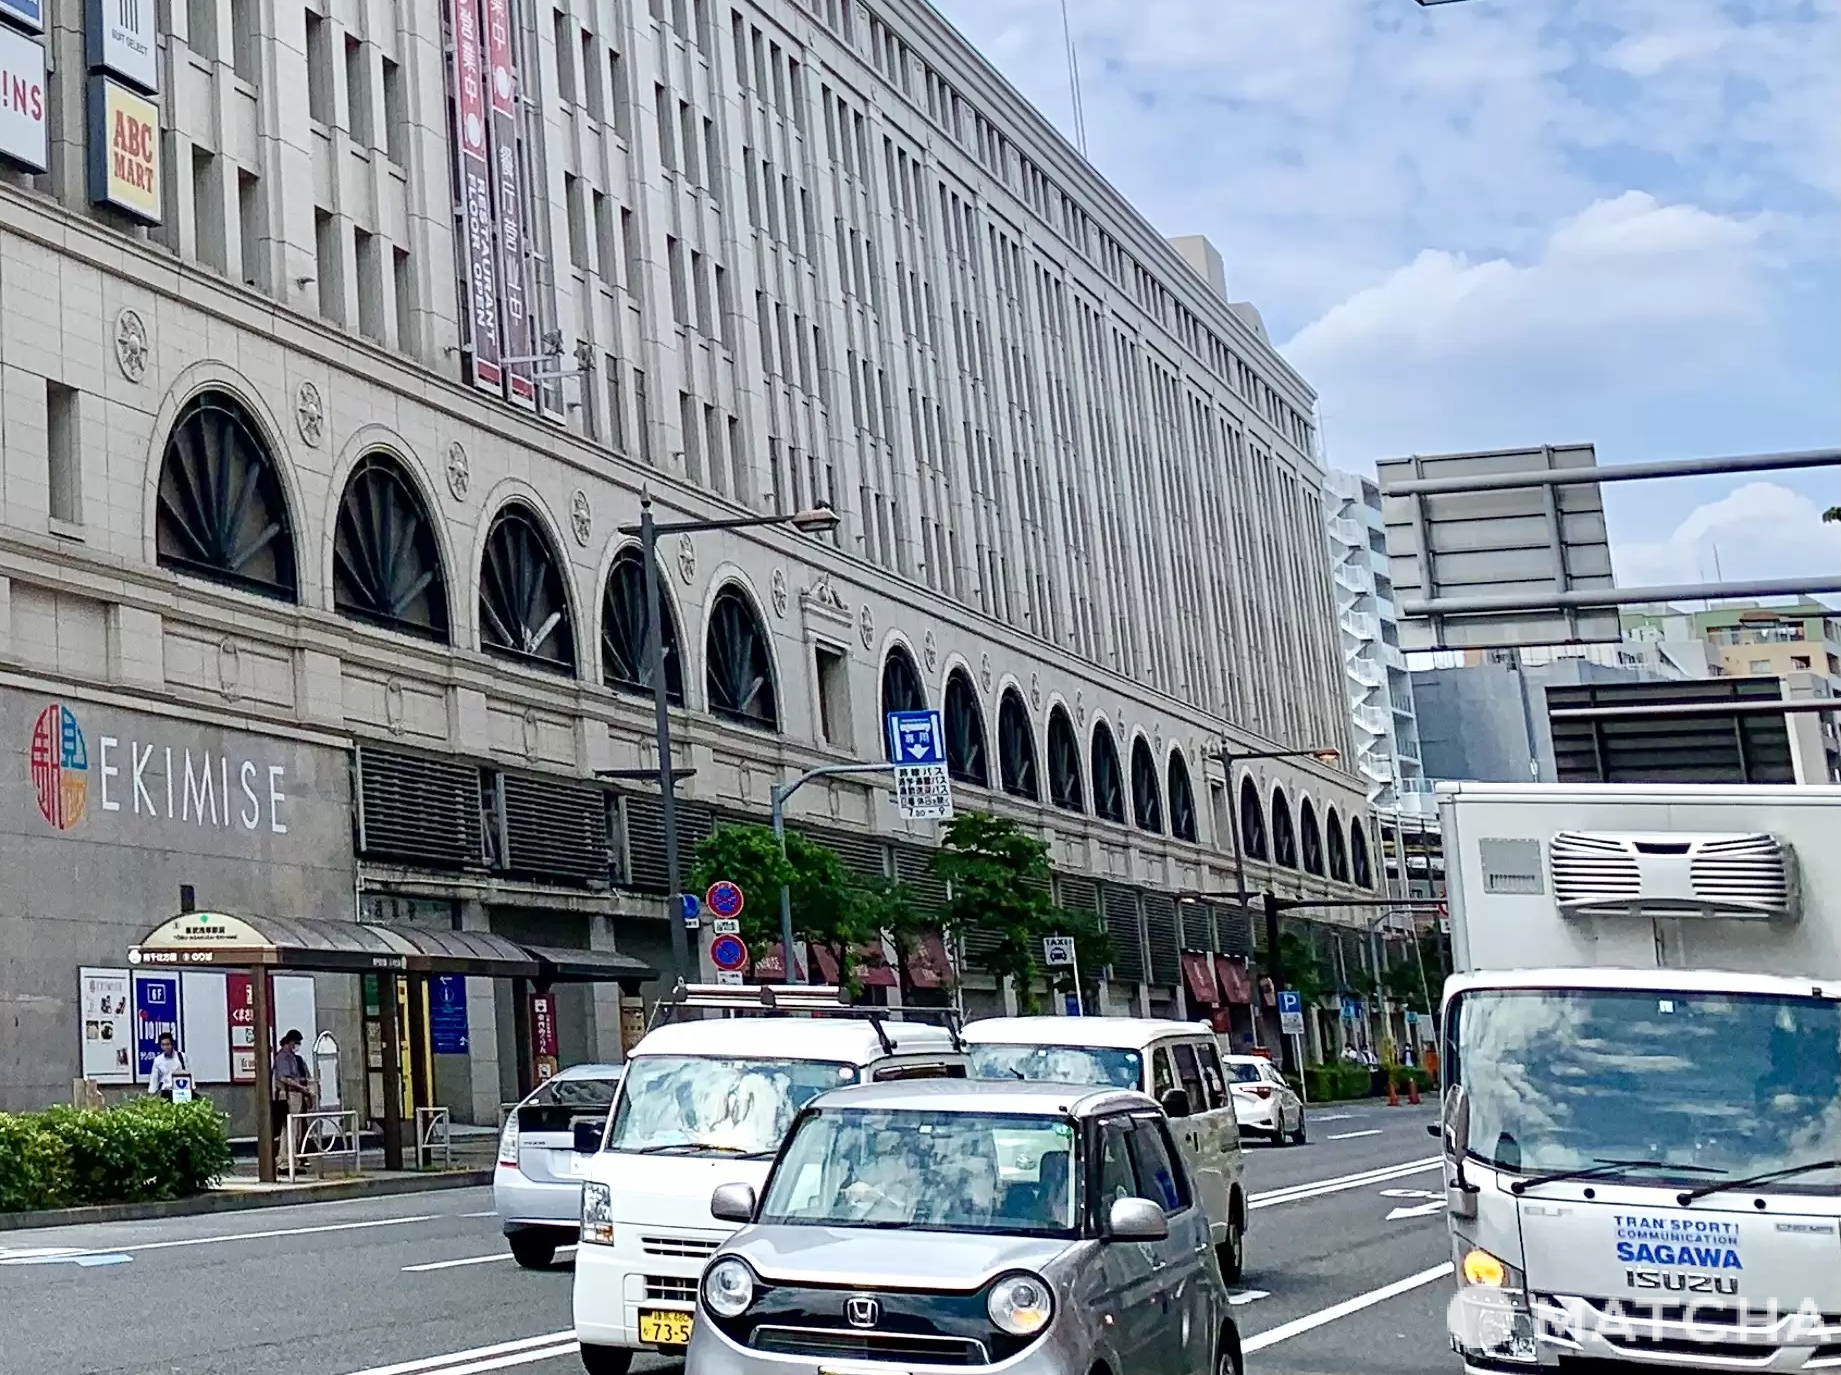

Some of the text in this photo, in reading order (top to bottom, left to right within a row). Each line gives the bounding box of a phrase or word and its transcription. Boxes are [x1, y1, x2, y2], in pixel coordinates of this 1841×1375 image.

[113, 109, 153, 164] ABC
[113, 152, 154, 194] MART
[467, 172, 487, 327] FLOOR OPEN
[476, 176, 495, 347] RESTAURANT
[100, 736, 287, 834] EKIMISE
[1617, 1228, 1738, 1245] COMMUNICATION
[1617, 1241, 1743, 1270] SAGAWA
[1626, 1266, 1739, 1295] ISUZU
[653, 1323, 690, 1343] 73-5
